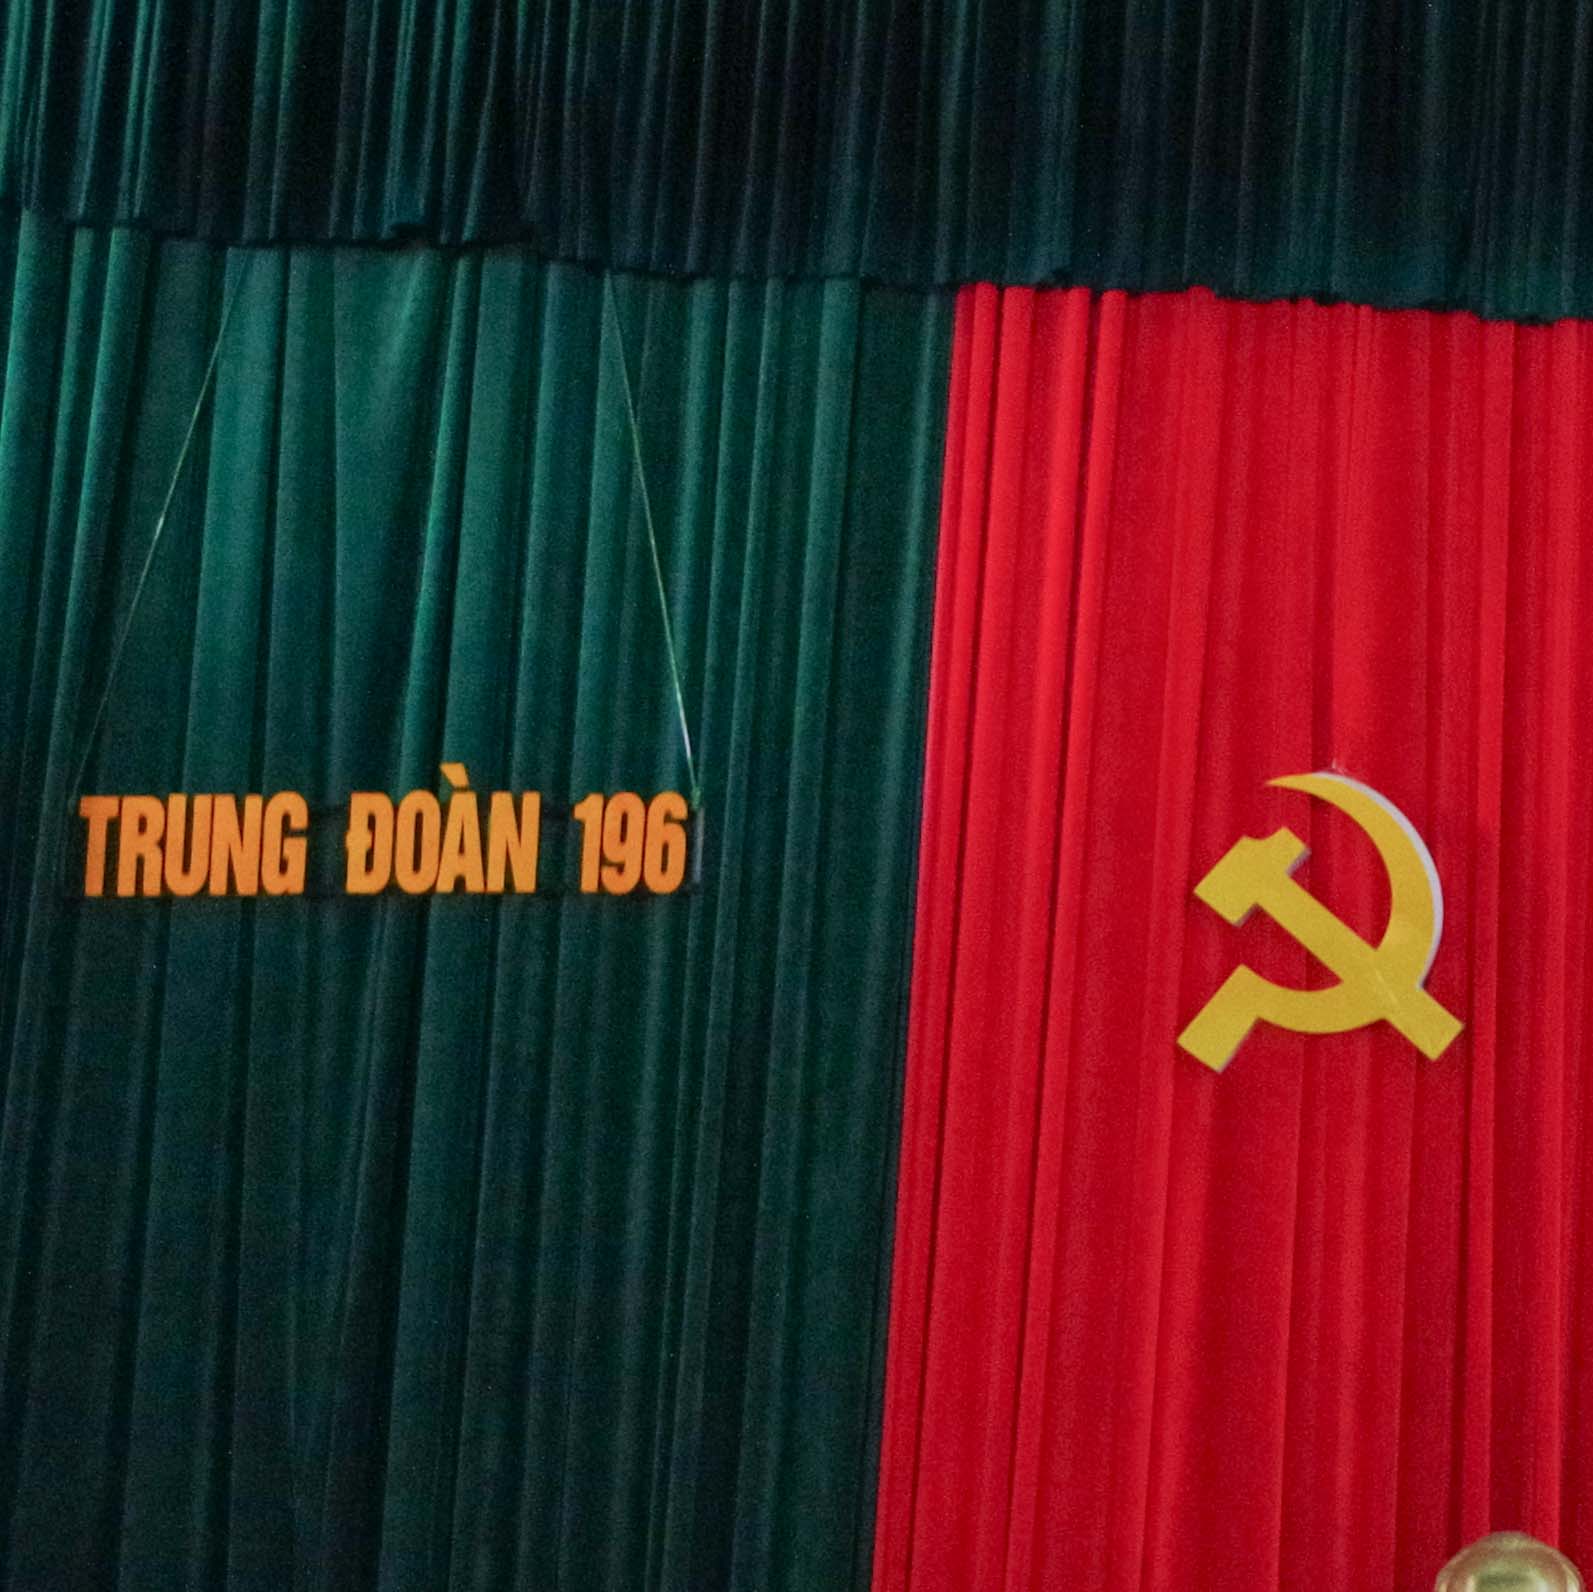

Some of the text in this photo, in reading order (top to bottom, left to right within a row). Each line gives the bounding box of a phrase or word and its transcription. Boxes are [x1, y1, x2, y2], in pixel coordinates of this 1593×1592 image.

[79, 761, 688, 897] TRUNG ĐOÀN 196
